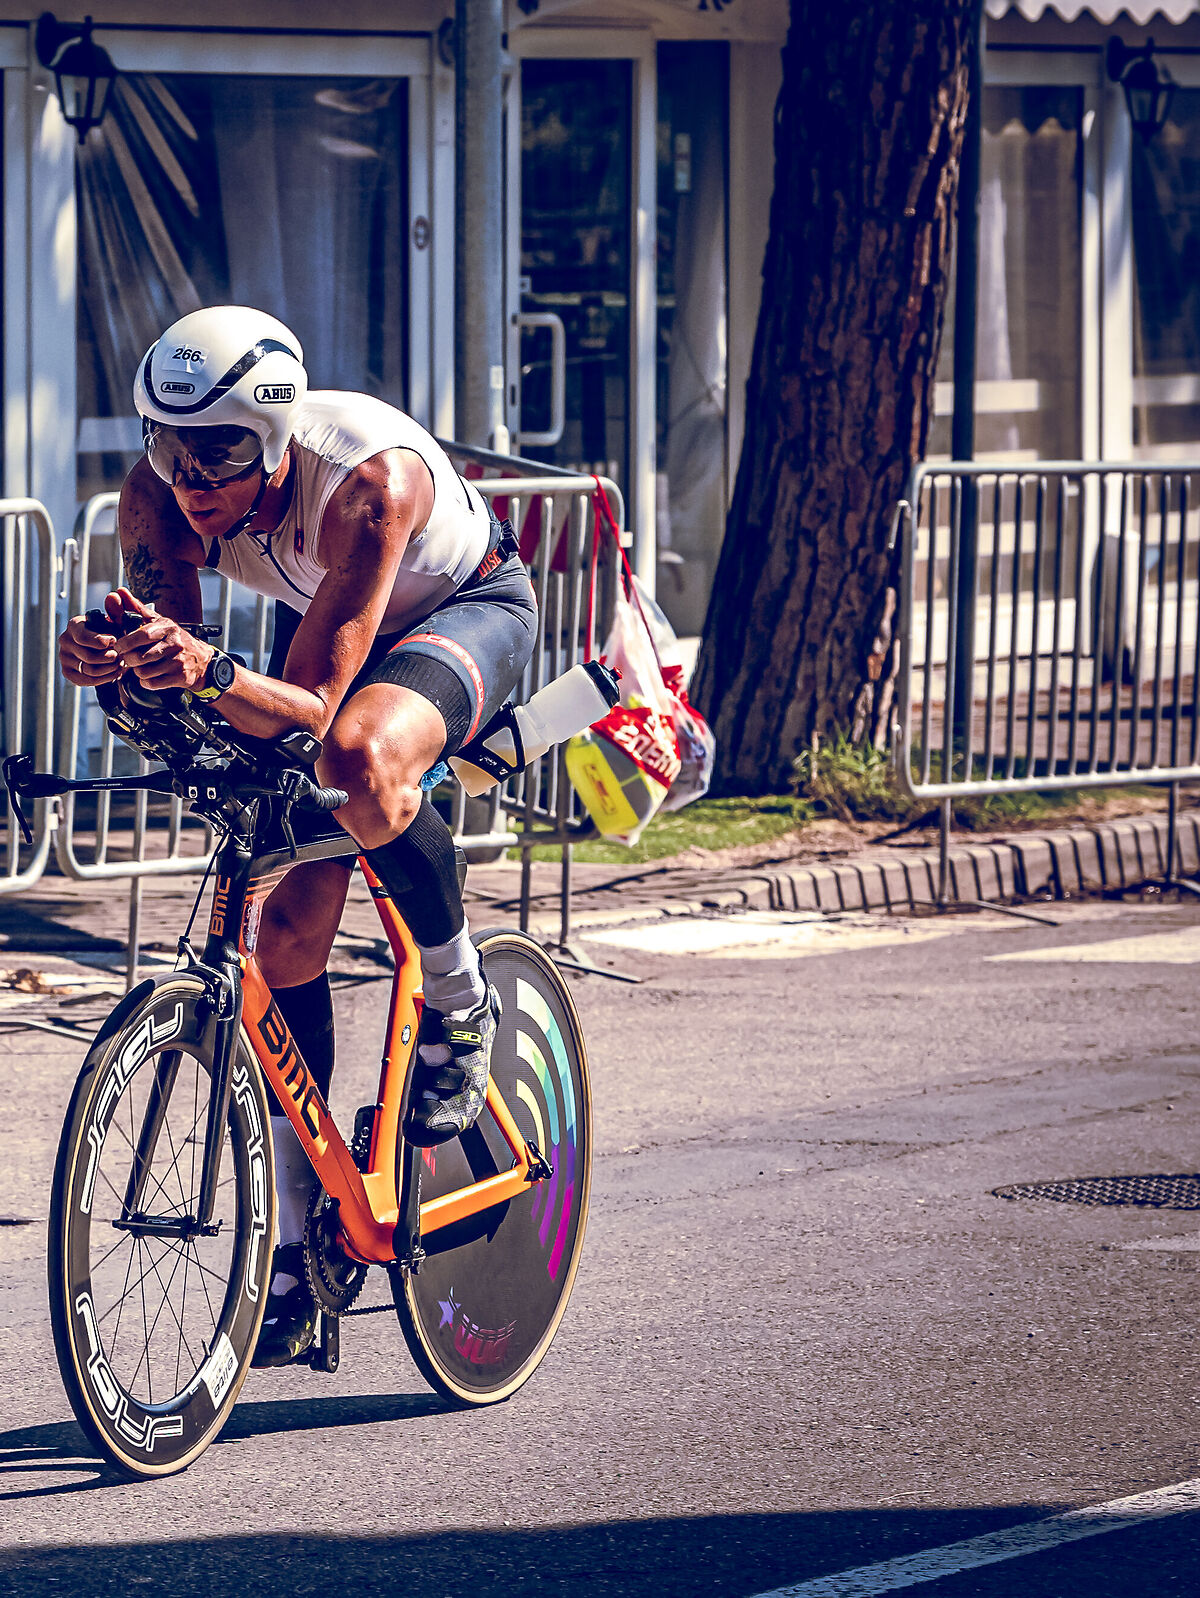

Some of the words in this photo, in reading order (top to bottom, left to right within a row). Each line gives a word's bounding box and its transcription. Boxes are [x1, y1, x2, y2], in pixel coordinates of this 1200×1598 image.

[171, 347, 202, 363] 266
[163, 383, 191, 393] ABUS
[260, 387, 292, 400] ABUS
[209, 874, 231, 937] BMC
[257, 996, 330, 1140] BMC
